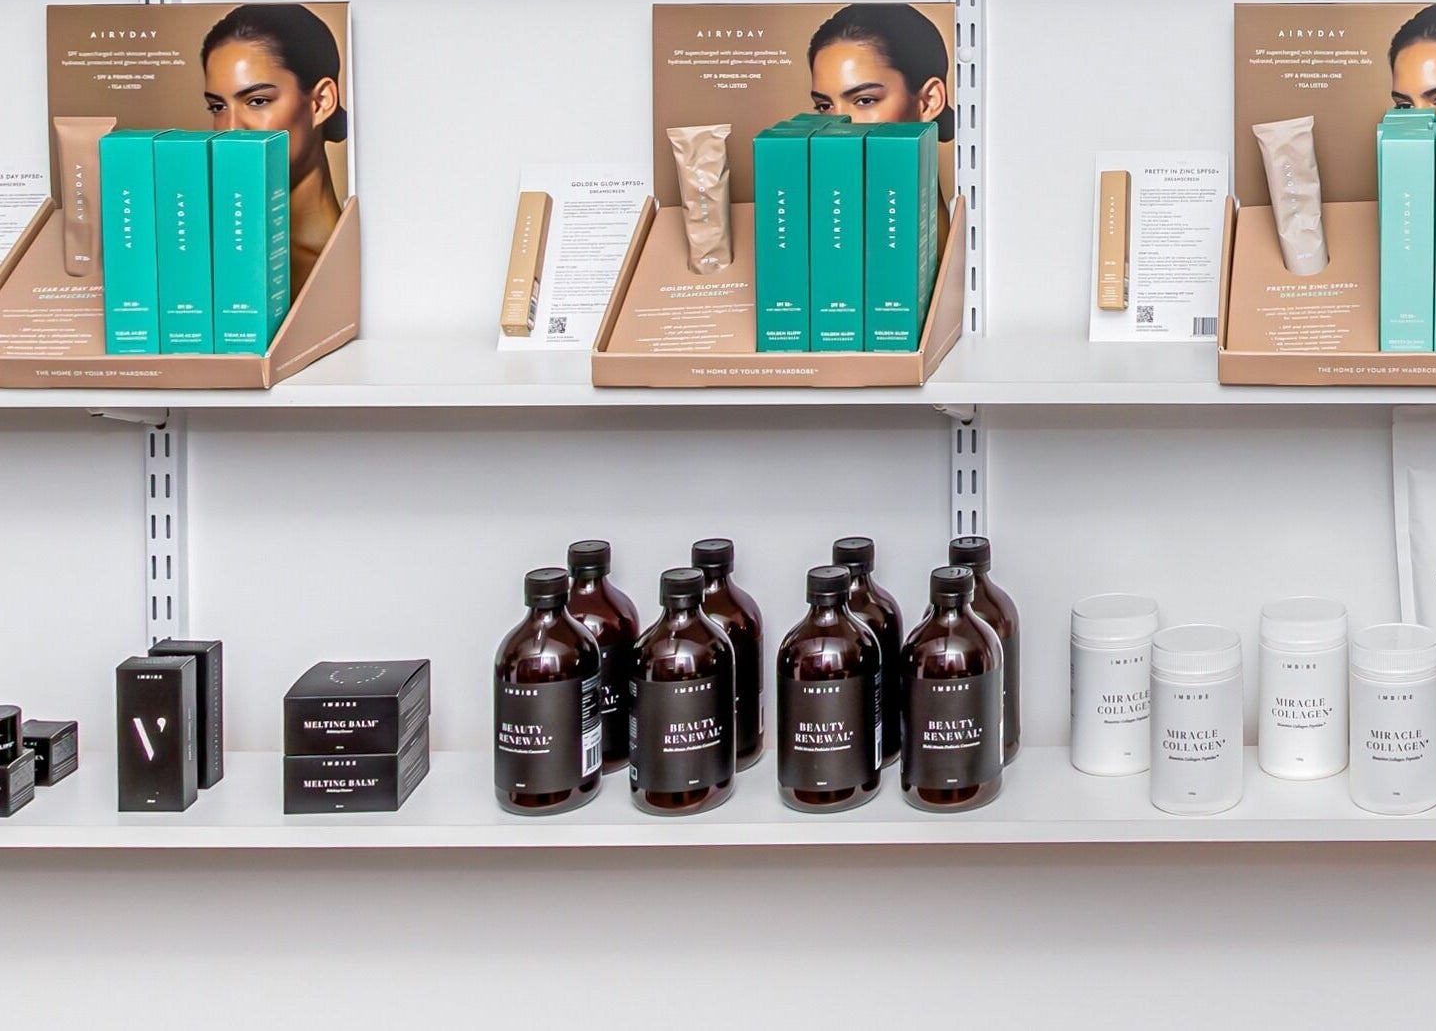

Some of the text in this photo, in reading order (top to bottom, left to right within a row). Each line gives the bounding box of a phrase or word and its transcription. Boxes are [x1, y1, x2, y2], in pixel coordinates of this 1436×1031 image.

[90, 31, 157, 39] AIRYDAY
[696, 30, 764, 38] AIRYDAY
[1278, 30, 1345, 38] AIRYDAY
[123, 189, 132, 249] AIRYDAY
[176, 192, 186, 252] AIRYDAY
[234, 192, 243, 252] AIRYDAY
[777, 189, 786, 249] AIRYDAY
[833, 189, 842, 249] AIRYDAY
[888, 189, 897, 249] AIRYDAY
[1403, 191, 1411, 251] AIRYDAY
[1282, 662, 1317, 670] IMBIBE
[1173, 693, 1210, 701] IMBIBE
[1275, 697, 1326, 709] MIRACLE
[1377, 693, 1414, 702] IMBIBE
[303, 720, 346, 729] MELTING
[501, 723, 543, 735] BEAUTY
[669, 717, 715, 733] BEAUTY
[799, 722, 845, 733] BEAUTY
[928, 718, 975, 730] BEAUTY
[1166, 729, 1219, 741] MIRACLE
[1369, 729, 1423, 741] MIRACLE
[303, 779, 346, 788] MELTING
